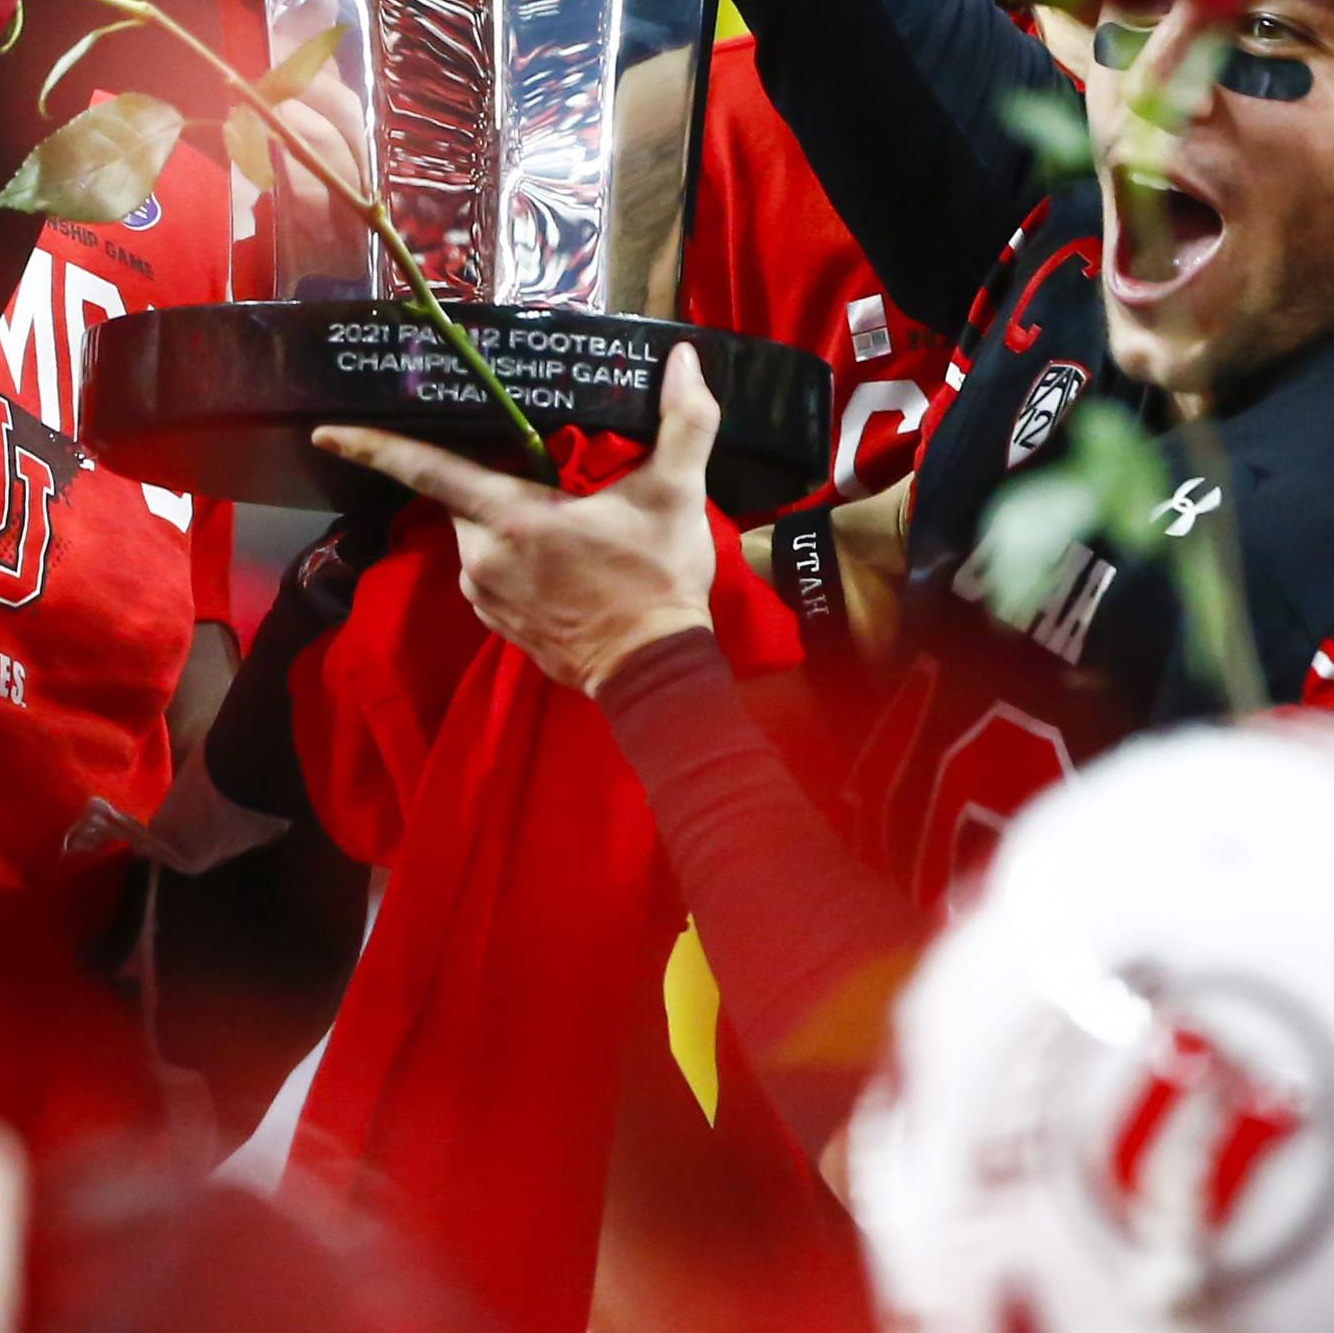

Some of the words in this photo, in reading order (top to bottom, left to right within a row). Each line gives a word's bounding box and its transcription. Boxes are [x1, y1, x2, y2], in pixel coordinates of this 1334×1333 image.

[105, 239, 155, 282] GAME
[327, 322, 390, 345] 2021
[509, 328, 660, 364] FOOTBALL
[336, 351, 565, 380] CHAMPISHIP
[571, 362, 651, 390] GAME
[415, 380, 577, 411] CHAPION
[792, 532, 830, 618] UTAH
